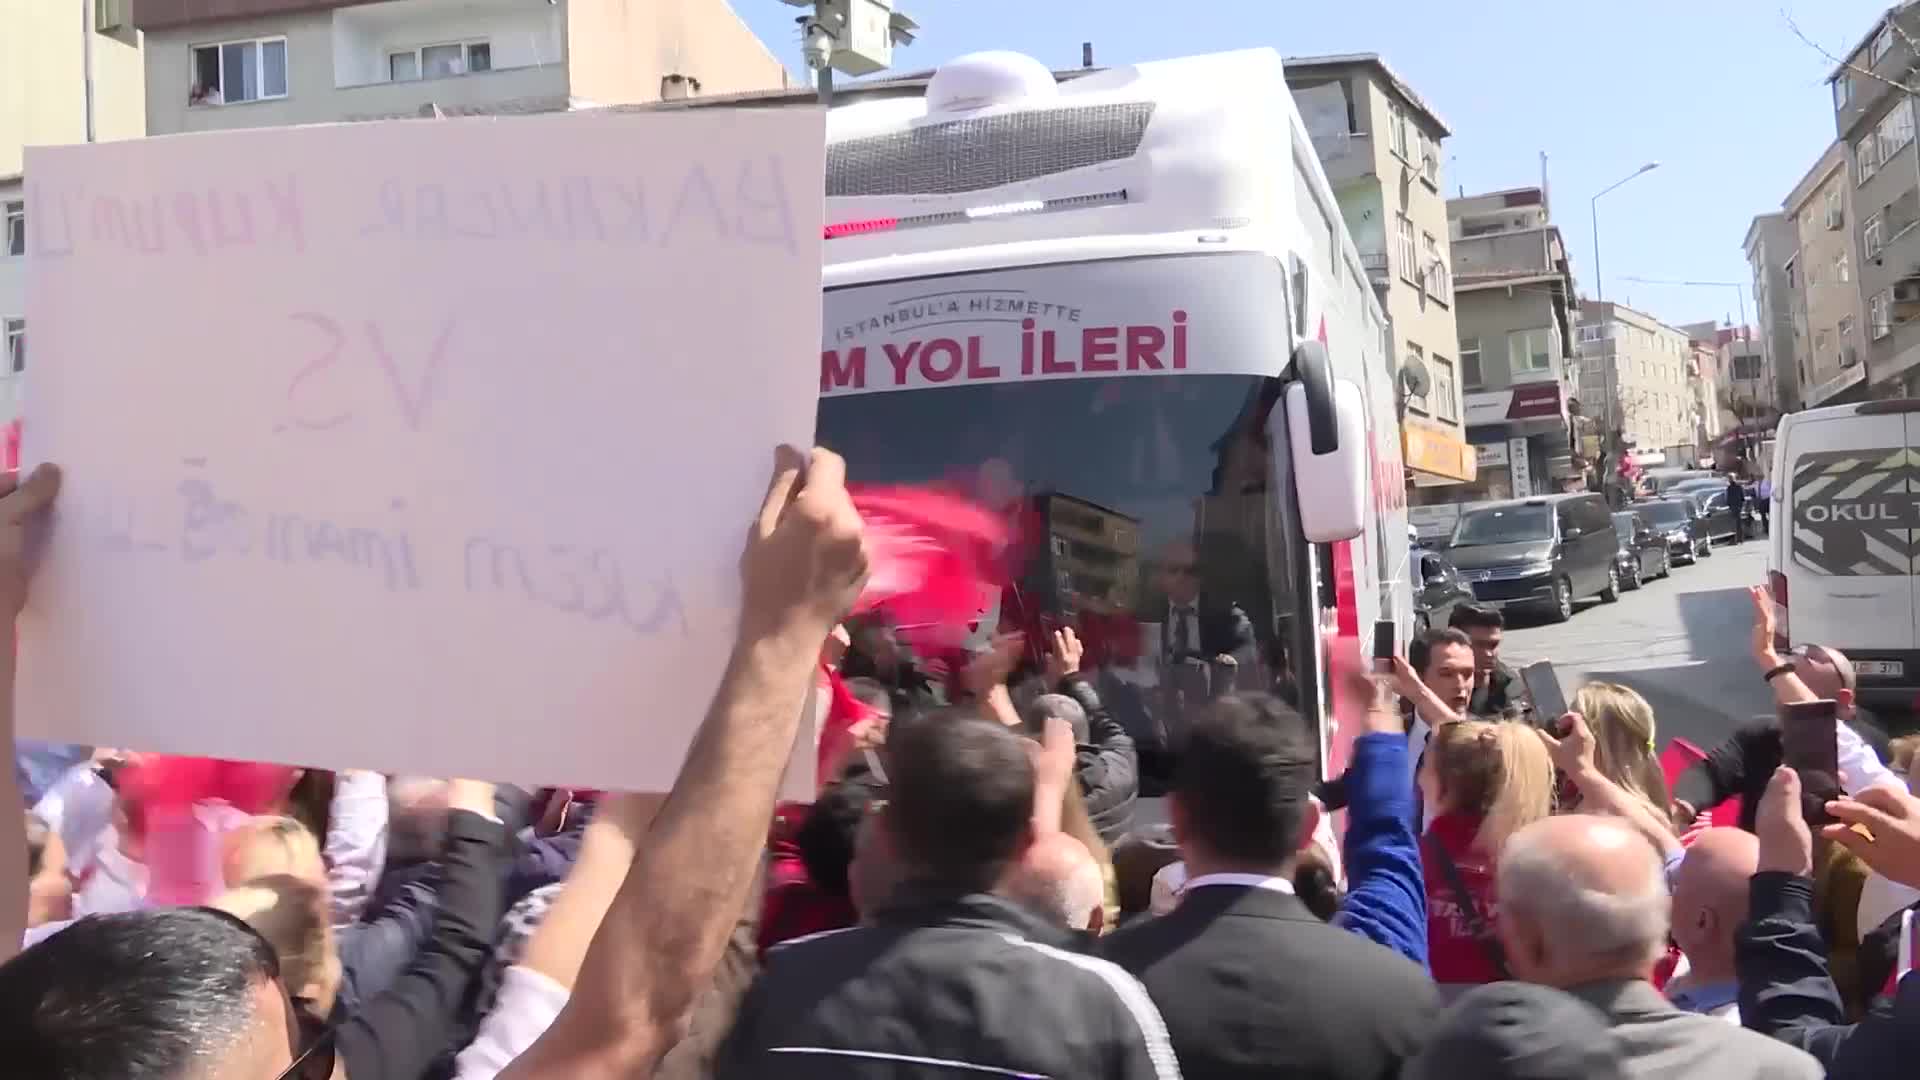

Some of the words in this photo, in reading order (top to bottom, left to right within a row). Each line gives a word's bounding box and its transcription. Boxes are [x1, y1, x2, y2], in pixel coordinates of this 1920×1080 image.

[835, 300, 959, 341] İSTANBUL'A
[970, 296, 1081, 323] HİZMETTE
[820, 346, 867, 393] M
[881, 336, 1001, 385] YOL
[1021, 310, 1188, 375] İLERİ
[1805, 503, 1899, 522] OKUL
